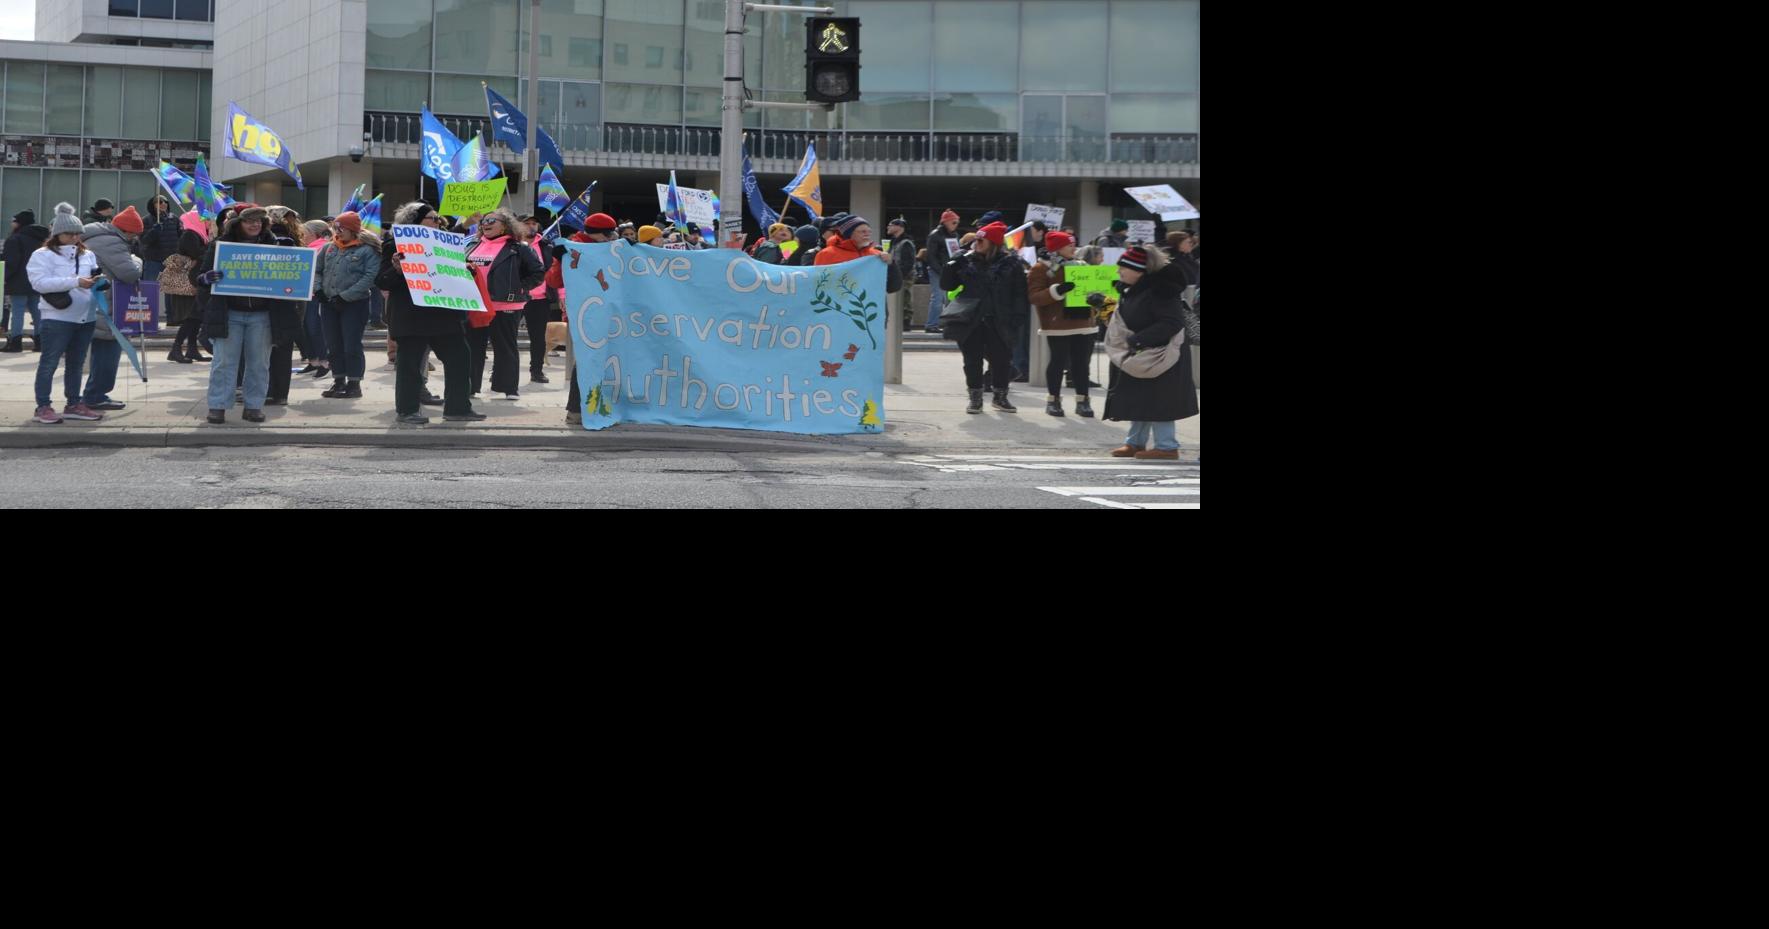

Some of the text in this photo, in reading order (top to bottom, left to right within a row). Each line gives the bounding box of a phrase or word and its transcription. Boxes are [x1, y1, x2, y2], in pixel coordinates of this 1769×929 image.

[447, 184, 476, 194] DOUG
[393, 226, 464, 246] DOUG FORD:
[397, 243, 425, 255] BAD
[231, 253, 301, 262] SAVE ONTARIO'S
[262, 261, 310, 272] FORESTS
[400, 262, 428, 274] BAD
[607, 241, 810, 295] Save Our
[240, 271, 301, 280] WETLANDS
[406, 279, 433, 291] BAD
[423, 295, 480, 309] ONTARIO
[602, 353, 862, 422] Authorities
